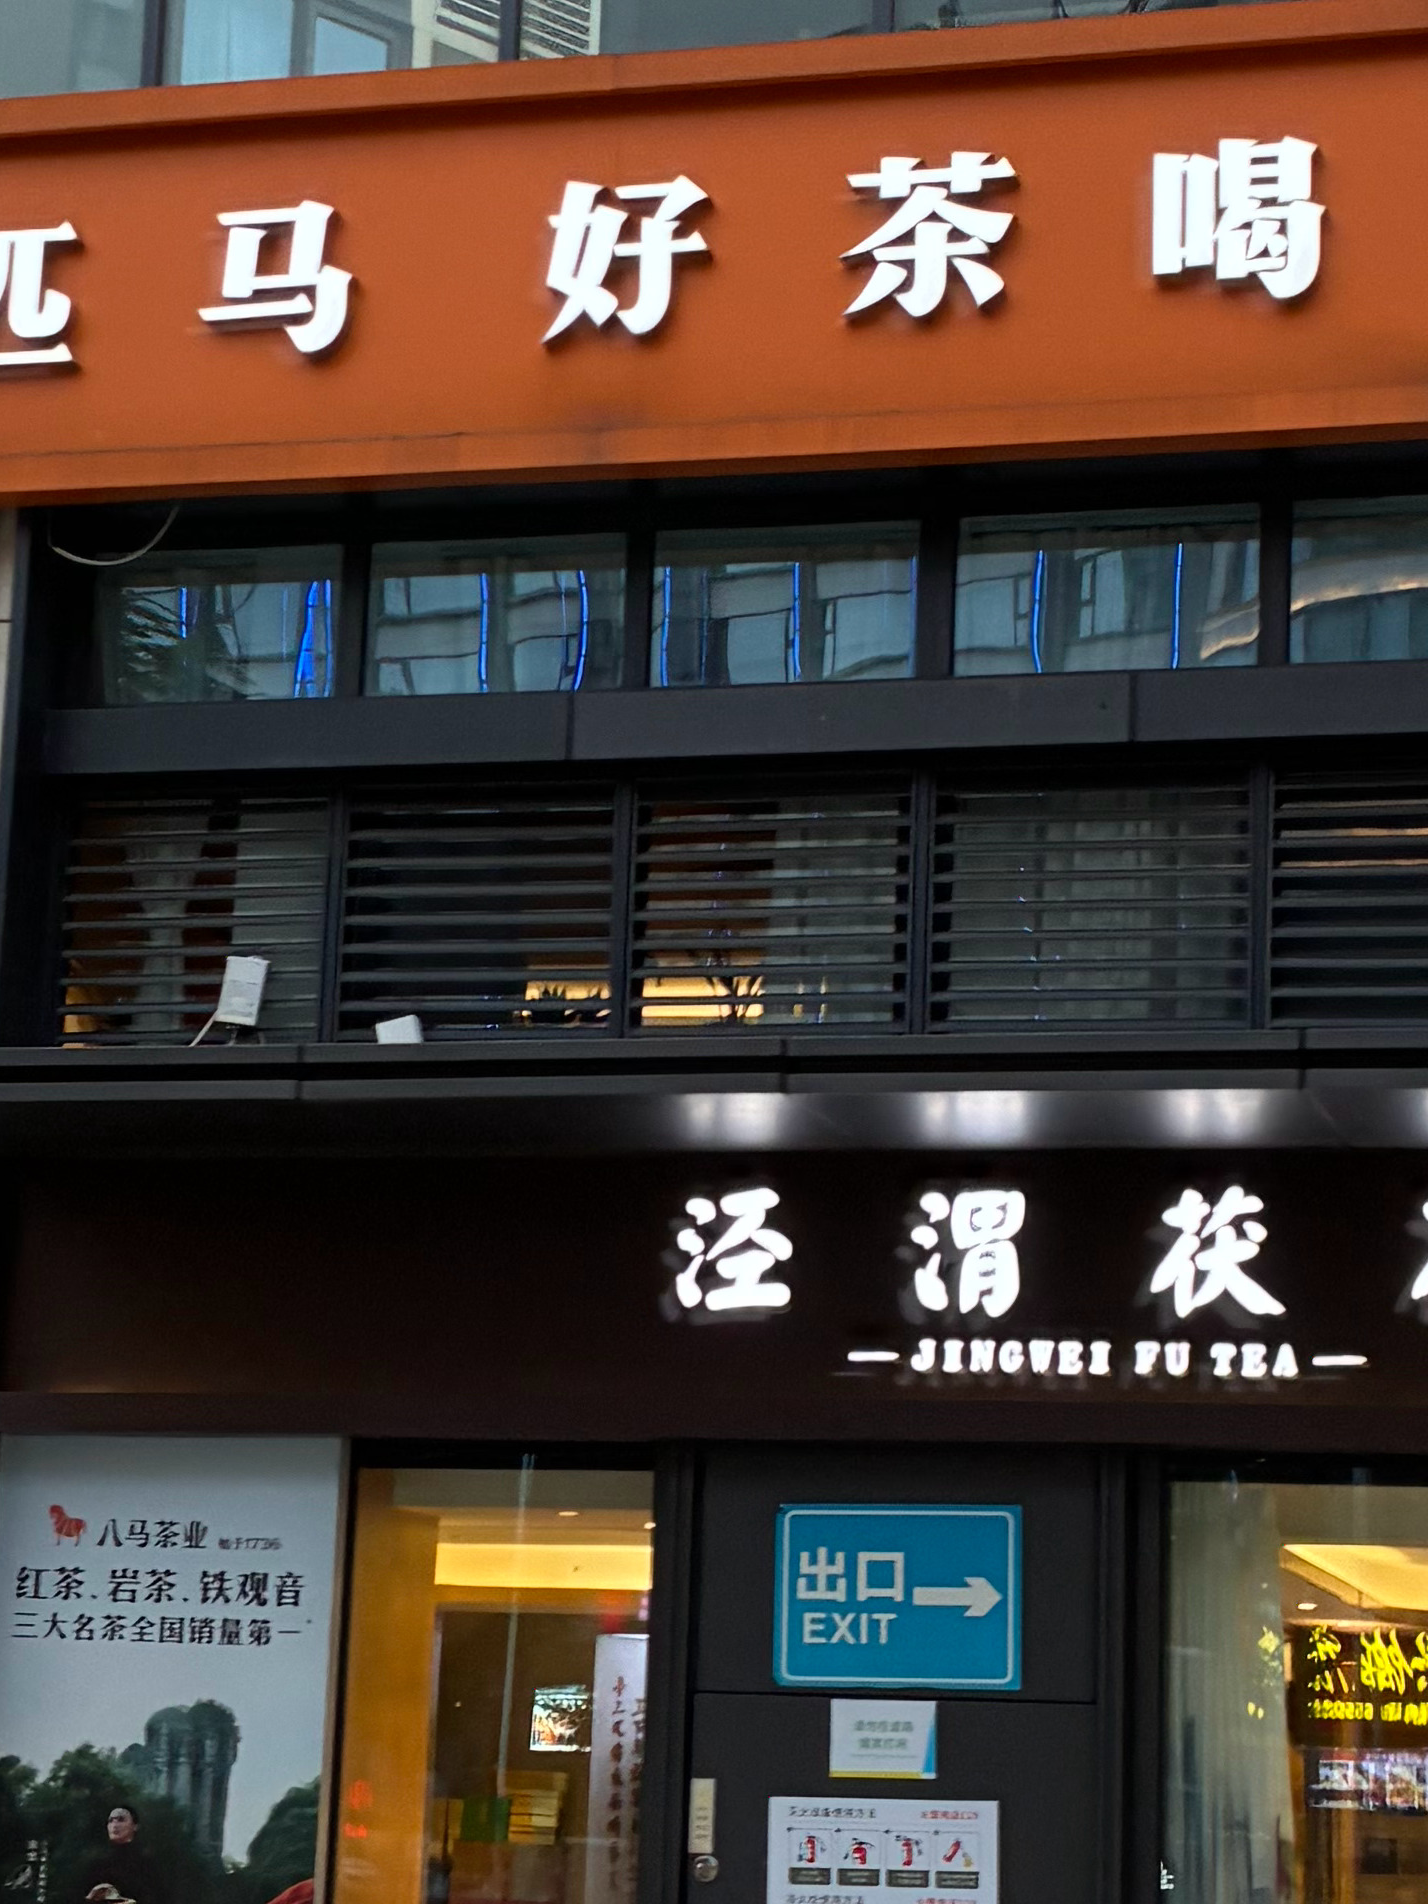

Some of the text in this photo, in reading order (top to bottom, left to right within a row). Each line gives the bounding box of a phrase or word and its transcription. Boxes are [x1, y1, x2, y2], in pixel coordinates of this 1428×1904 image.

[910, 1337, 1299, 1379] JINGWEI FU TEA
[96, 1518, 209, 1549] 八马茶业
[796, 1546, 905, 1603] 出口
[802, 1612, 898, 1645] EXIT
